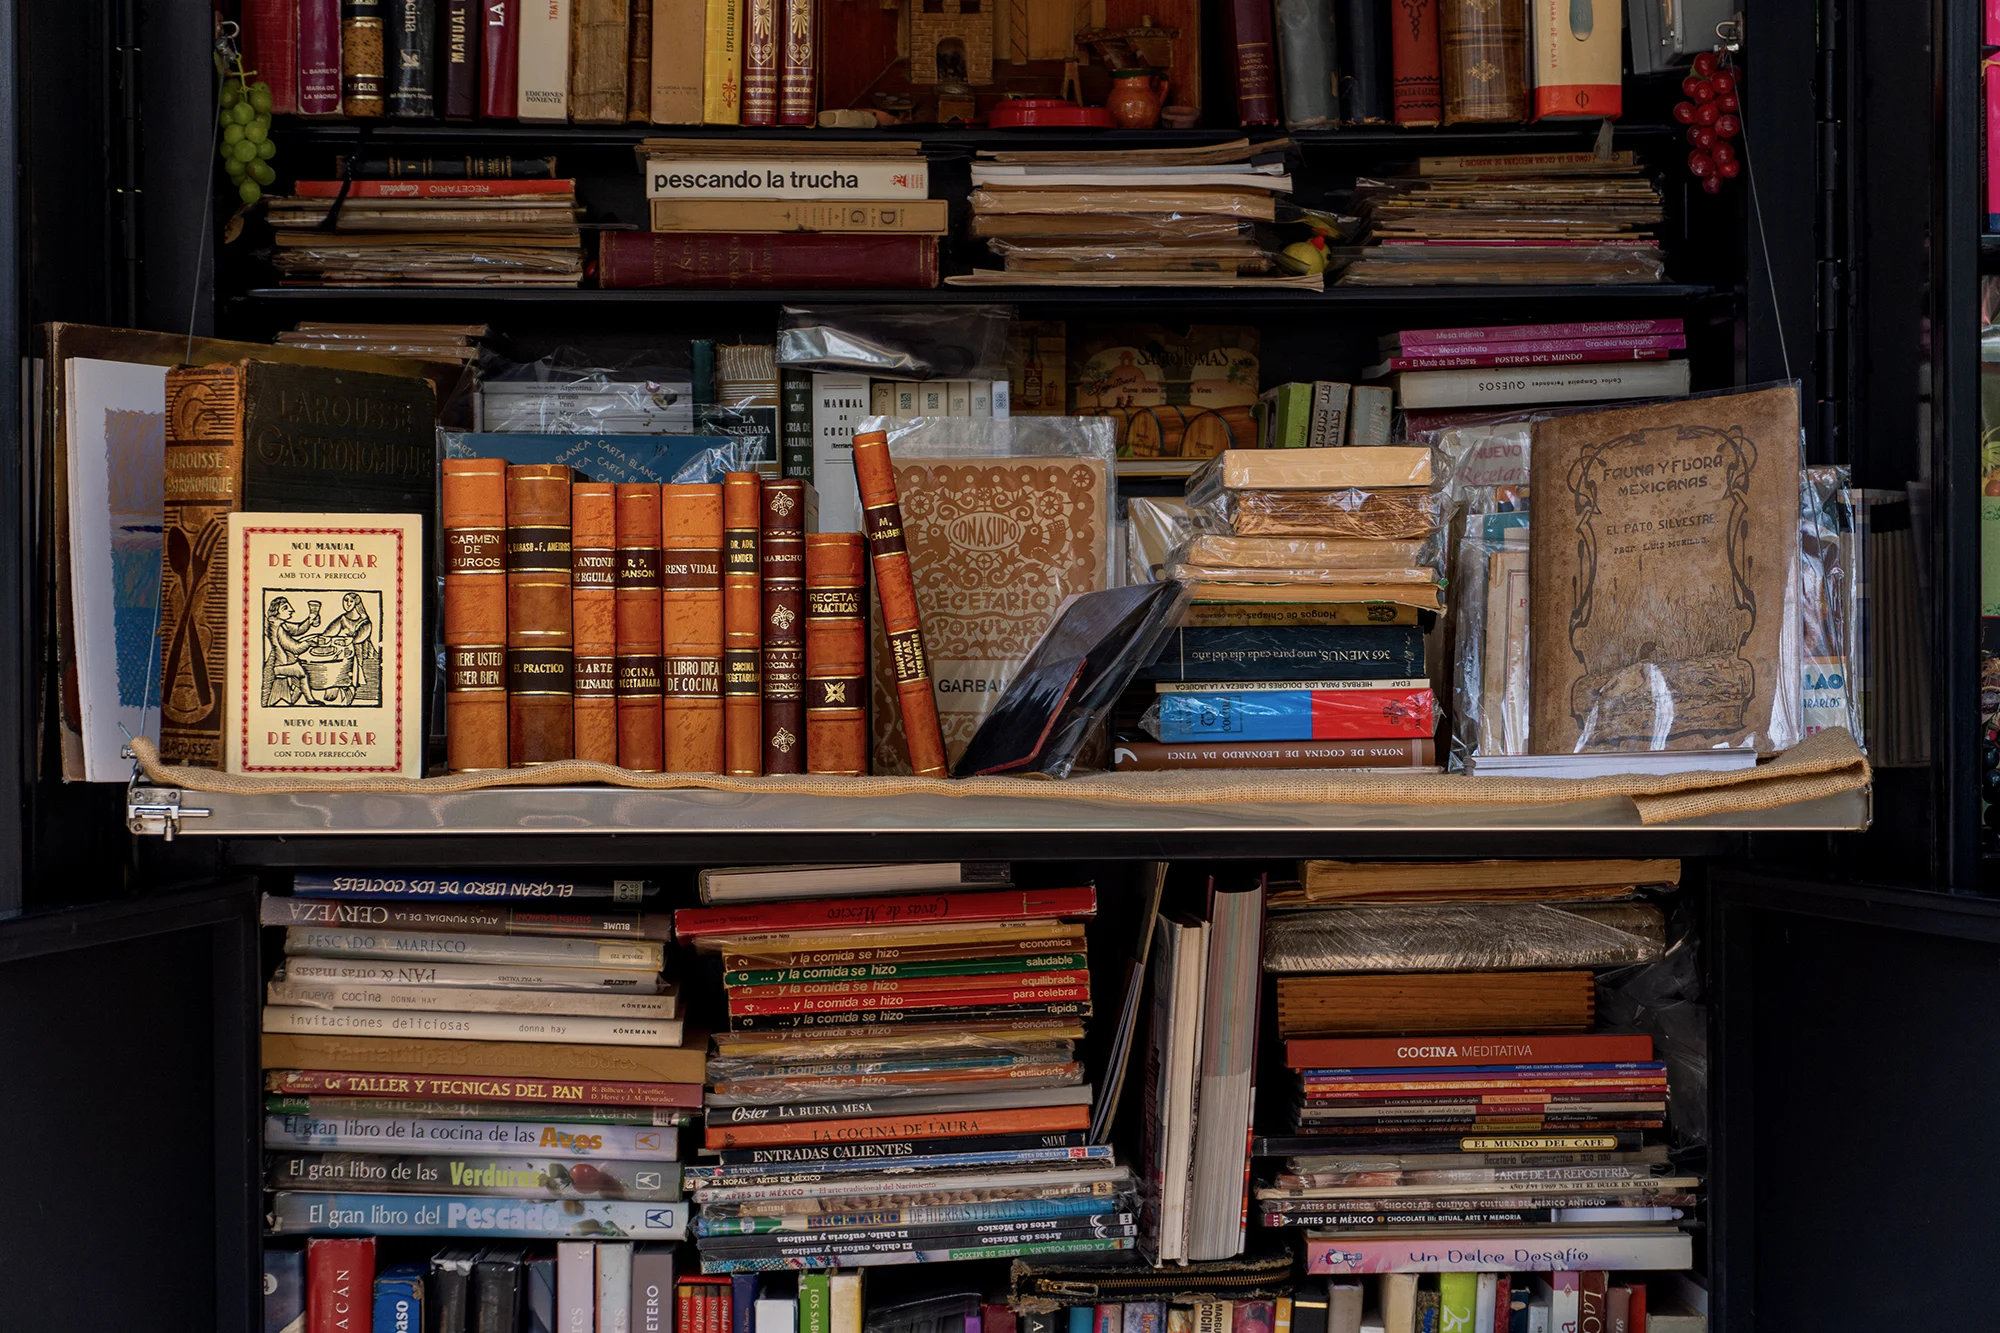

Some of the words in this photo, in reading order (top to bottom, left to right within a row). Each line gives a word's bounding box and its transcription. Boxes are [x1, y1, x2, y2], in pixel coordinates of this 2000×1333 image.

[489, 1, 505, 27] LA
[451, 8, 466, 64] MANUAL
[1551, 42, 1559, 70] PLATA
[1503, 156, 1534, 165] MEXICANA
[1535, 155, 1556, 164] COCINA
[654, 169, 761, 192] pescando
[767, 169, 784, 189] la
[790, 169, 859, 189] trucha
[1438, 345, 1460, 354] Mesa
[1584, 340, 1618, 348] Graciela
[1618, 338, 1653, 346] Montaño
[1419, 358, 1438, 367] Mundo
[1438, 358, 1446, 366] de
[1446, 358, 1455, 366] los
[1456, 356, 1476, 366] Postres
[560, 384, 592, 393] Argentina
[1478, 380, 1525, 392] QUESOS
[824, 398, 864, 408] MANUAL
[1604, 464, 1654, 481] FAUNA
[1658, 461, 1672, 474] Y
[1672, 454, 1722, 473] FLORA
[1606, 526, 1619, 536] EL
[1624, 521, 1653, 534] PATO
[450, 534, 500, 545] CARMEN
[291, 542, 312, 551] NOU
[316, 542, 355, 551] MANUAL
[464, 546, 481, 554] DE
[269, 553, 292, 568] DE
[303, 553, 378, 568] CUINAR
[810, 592, 860, 602] RECETAS
[812, 602, 858, 614] PRACTICAS
[477, 652, 504, 666] USTED
[892, 639, 908, 679] LIMPIAR
[1192, 651, 1211, 662] año
[1211, 651, 1226, 662] del
[1226, 651, 1246, 662] día
[1248, 650, 1270, 662] cada
[1272, 648, 1296, 660] para
[1296, 650, 1317, 659] uno
[1372, 649, 1391, 660] 365
[620, 667, 655, 678] COCINA
[284, 718, 314, 728] NUEVO
[319, 718, 358, 728] MANUAL
[267, 732, 290, 746] DE
[301, 732, 377, 746] GUISAR
[1168, 752, 1197, 760] VINCI
[1203, 752, 1217, 760] DA
[1222, 750, 1280, 760] LEONARDO
[1285, 750, 1299, 758] DE
[1304, 749, 1345, 758] COCINA
[1350, 749, 1364, 757] DE
[1370, 748, 1404, 757] NOTAS
[332, 877, 406, 893] COCTELES
[410, 880, 434, 894] LOS
[440, 880, 460, 895] DE
[465, 880, 506, 897] LIBRO
[509, 881, 554, 897] GRAN
[559, 884, 574, 898] EL
[286, 904, 388, 924] CERVEZA
[394, 912, 405, 922] LA
[406, 912, 418, 923] DE
[422, 914, 468, 924] MUNDIAL
[470, 916, 498, 926] ATLAS
[603, 921, 631, 931] BLUME
[307, 932, 376, 950] PESCADO
[396, 938, 466, 953] MARISCO
[296, 966, 337, 976] masas
[342, 968, 376, 980] otras
[738, 972, 749, 981] 6
[777, 969, 785, 982] y
[789, 968, 800, 978] la
[802, 966, 849, 978] comida
[850, 966, 866, 976] se
[870, 964, 896, 975] hizo
[1026, 955, 1073, 967] saludable
[380, 970, 394, 980] &
[398, 968, 436, 983] PAN
[792, 1000, 800, 1010] y
[802, 999, 813, 1008] la
[814, 997, 858, 1008] comida
[862, 998, 876, 1007] se
[880, 996, 904, 1006] hizo
[1013, 989, 1036, 1000] para
[1038, 986, 1078, 998] celebrar
[1396, 1046, 1458, 1059] COCINA
[1461, 1044, 1533, 1057] MEDITATIVA
[731, 1106, 769, 1122] Oster
[778, 1106, 795, 1117] LA
[800, 1104, 838, 1116] BUENA
[842, 1102, 873, 1113] MESA
[284, 1117, 297, 1133] El
[303, 1121, 338, 1137] gran
[344, 1120, 381, 1138] libro
[386, 1121, 406, 1138] de
[412, 1121, 425, 1139] la
[431, 1124, 483, 1141] cocina
[488, 1125, 508, 1142] de
[514, 1126, 536, 1142] las
[539, 1127, 603, 1150] Aves
[813, 1129, 831, 1142] LA
[837, 1126, 896, 1140] COCINA
[904, 1124, 922, 1136] DE
[929, 1120, 980, 1134] LAURA
[1474, 1140, 1489, 1148] EL
[1494, 1140, 1538, 1148] MUNDO
[1544, 1140, 1568, 1148] DEL
[290, 1159, 304, 1176] El
[308, 1163, 344, 1180] gran
[350, 1160, 387, 1179] libro
[391, 1162, 412, 1180] de
[416, 1163, 439, 1181] las
[450, 1161, 540, 1188] Verduras
[310, 1204, 323, 1223] El
[328, 1210, 364, 1229] gran
[371, 1204, 408, 1225] libro
[414, 1205, 440, 1225] del
[448, 1202, 560, 1231] Pescado
[977, 1224, 1014, 1232] México
[1030, 1221, 1058, 1230] Artes
[982, 1234, 1019, 1244] México
[1034, 1232, 1062, 1240] Artes
[1410, 1252, 1438, 1262] Un
[1448, 1248, 1505, 1264] Dulce
[1514, 1247, 1589, 1263] Desafío
[646, 1284, 659, 1331] ETERO
